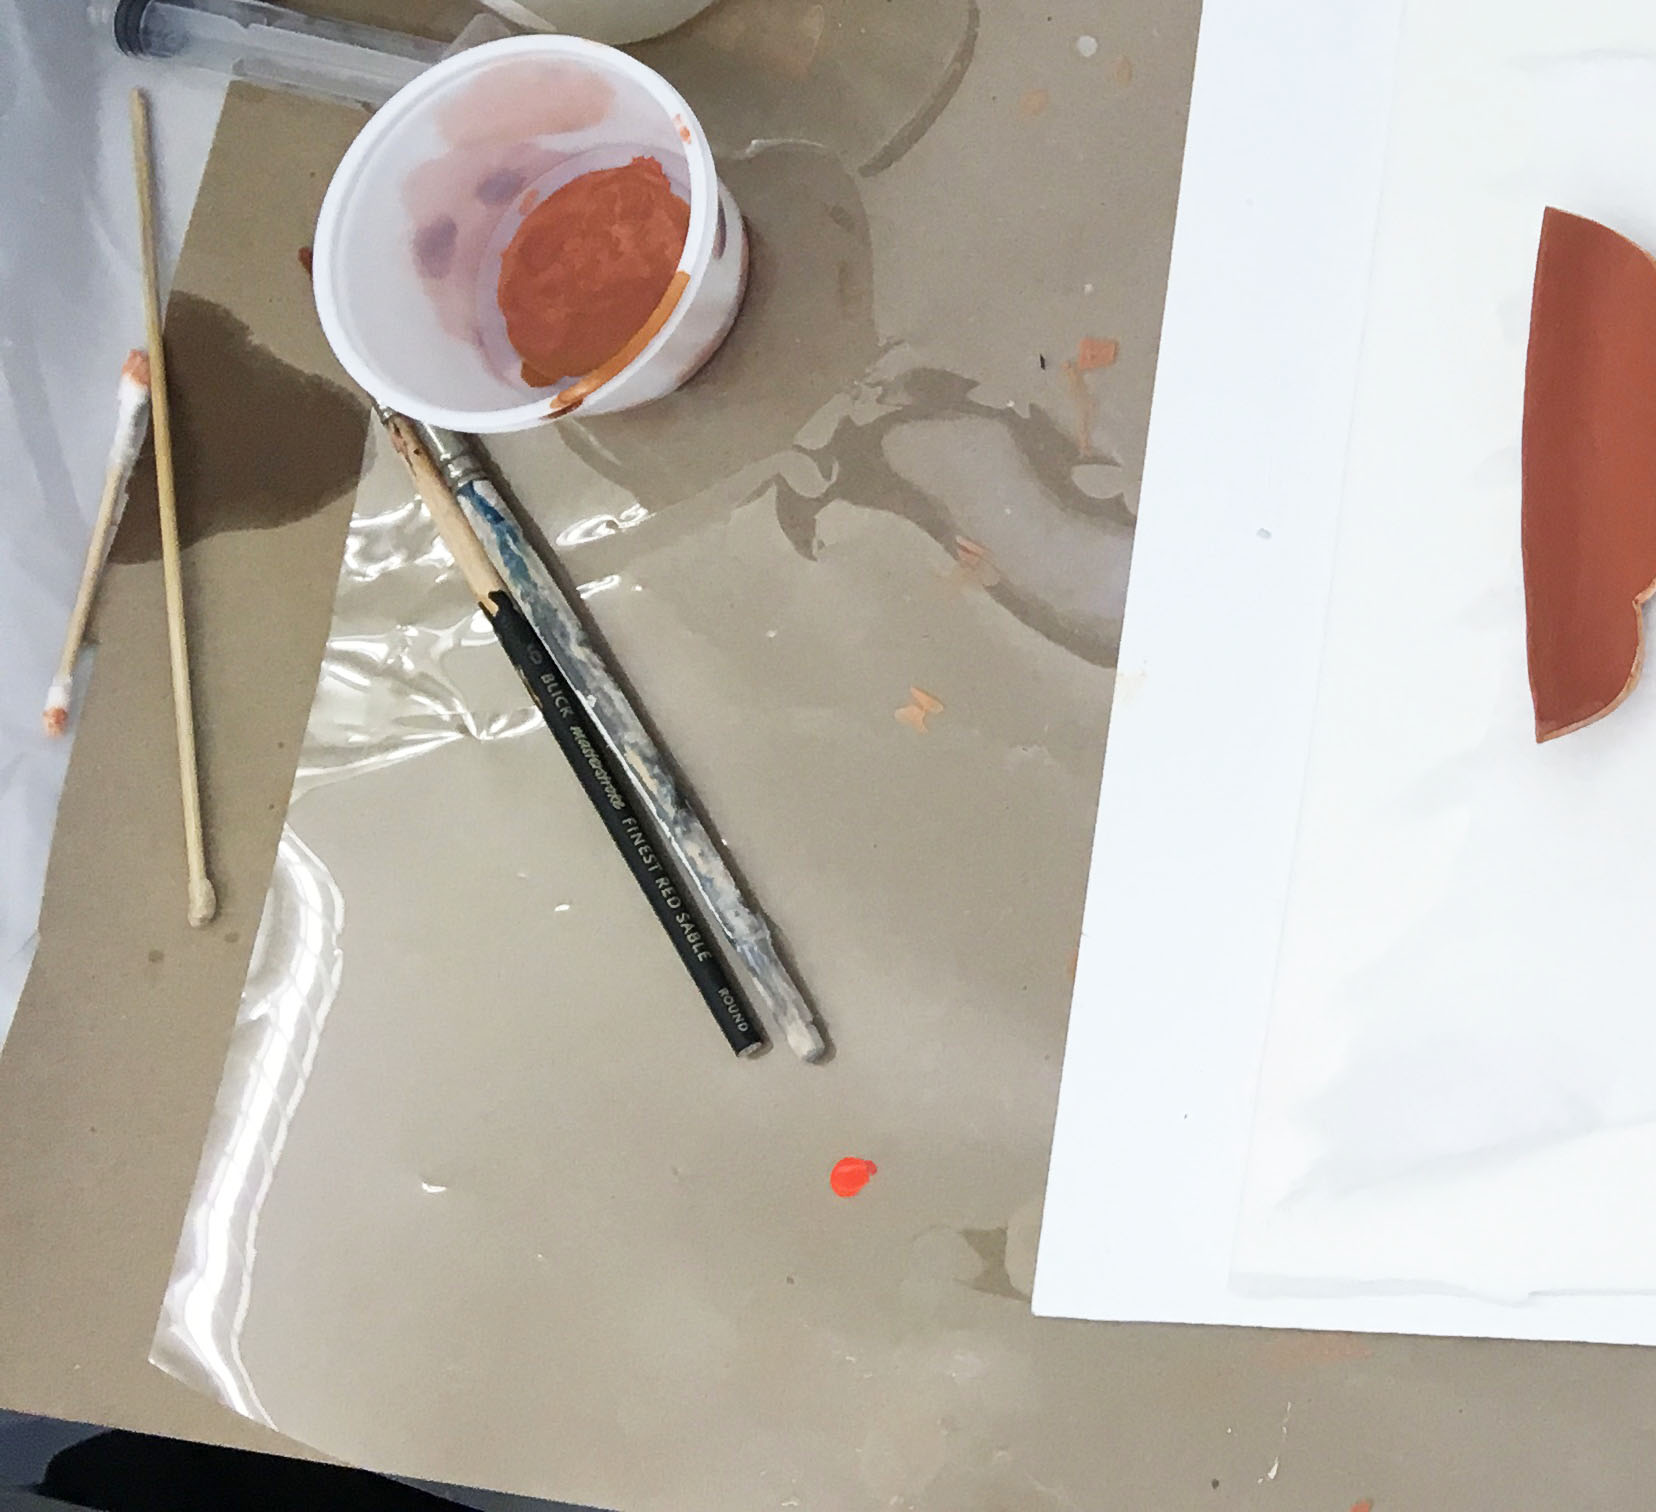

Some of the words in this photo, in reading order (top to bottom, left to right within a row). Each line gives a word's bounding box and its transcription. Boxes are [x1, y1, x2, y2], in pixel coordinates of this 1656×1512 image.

[540, 673, 575, 719] BLICK
[621, 816, 664, 873] FINEST
[654, 876, 682, 911] RED
[674, 910, 713, 963] SABLE
[717, 986, 751, 1034] ROUND
